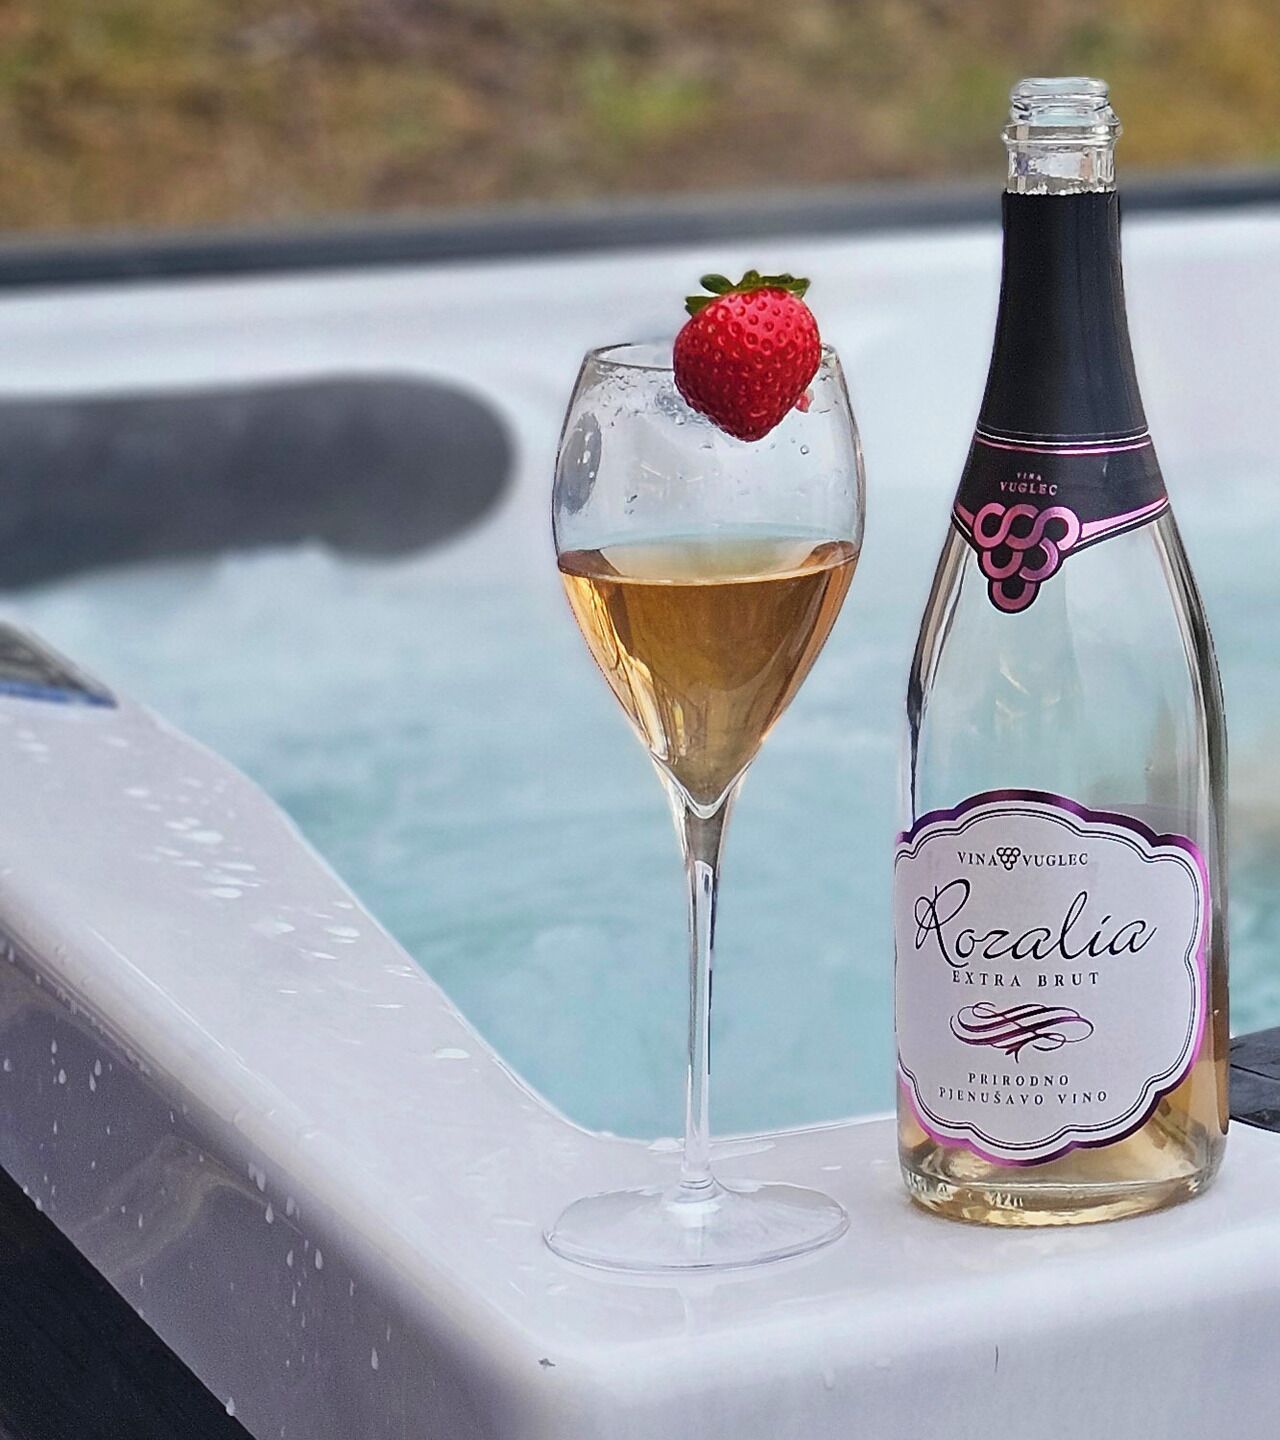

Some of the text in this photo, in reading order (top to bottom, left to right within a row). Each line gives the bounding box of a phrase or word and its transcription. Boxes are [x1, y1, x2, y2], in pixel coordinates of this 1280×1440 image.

[1000, 481, 1058, 497] VUGLEC
[957, 850, 1089, 867] VINA VUGLEC
[914, 878, 1157, 968] Rozalia
[952, 970, 1100, 987] EXTRA BRUT
[968, 1071, 1070, 1086] PRIRODNO
[939, 1086, 1108, 1105] PJENUŠAVO VINO
